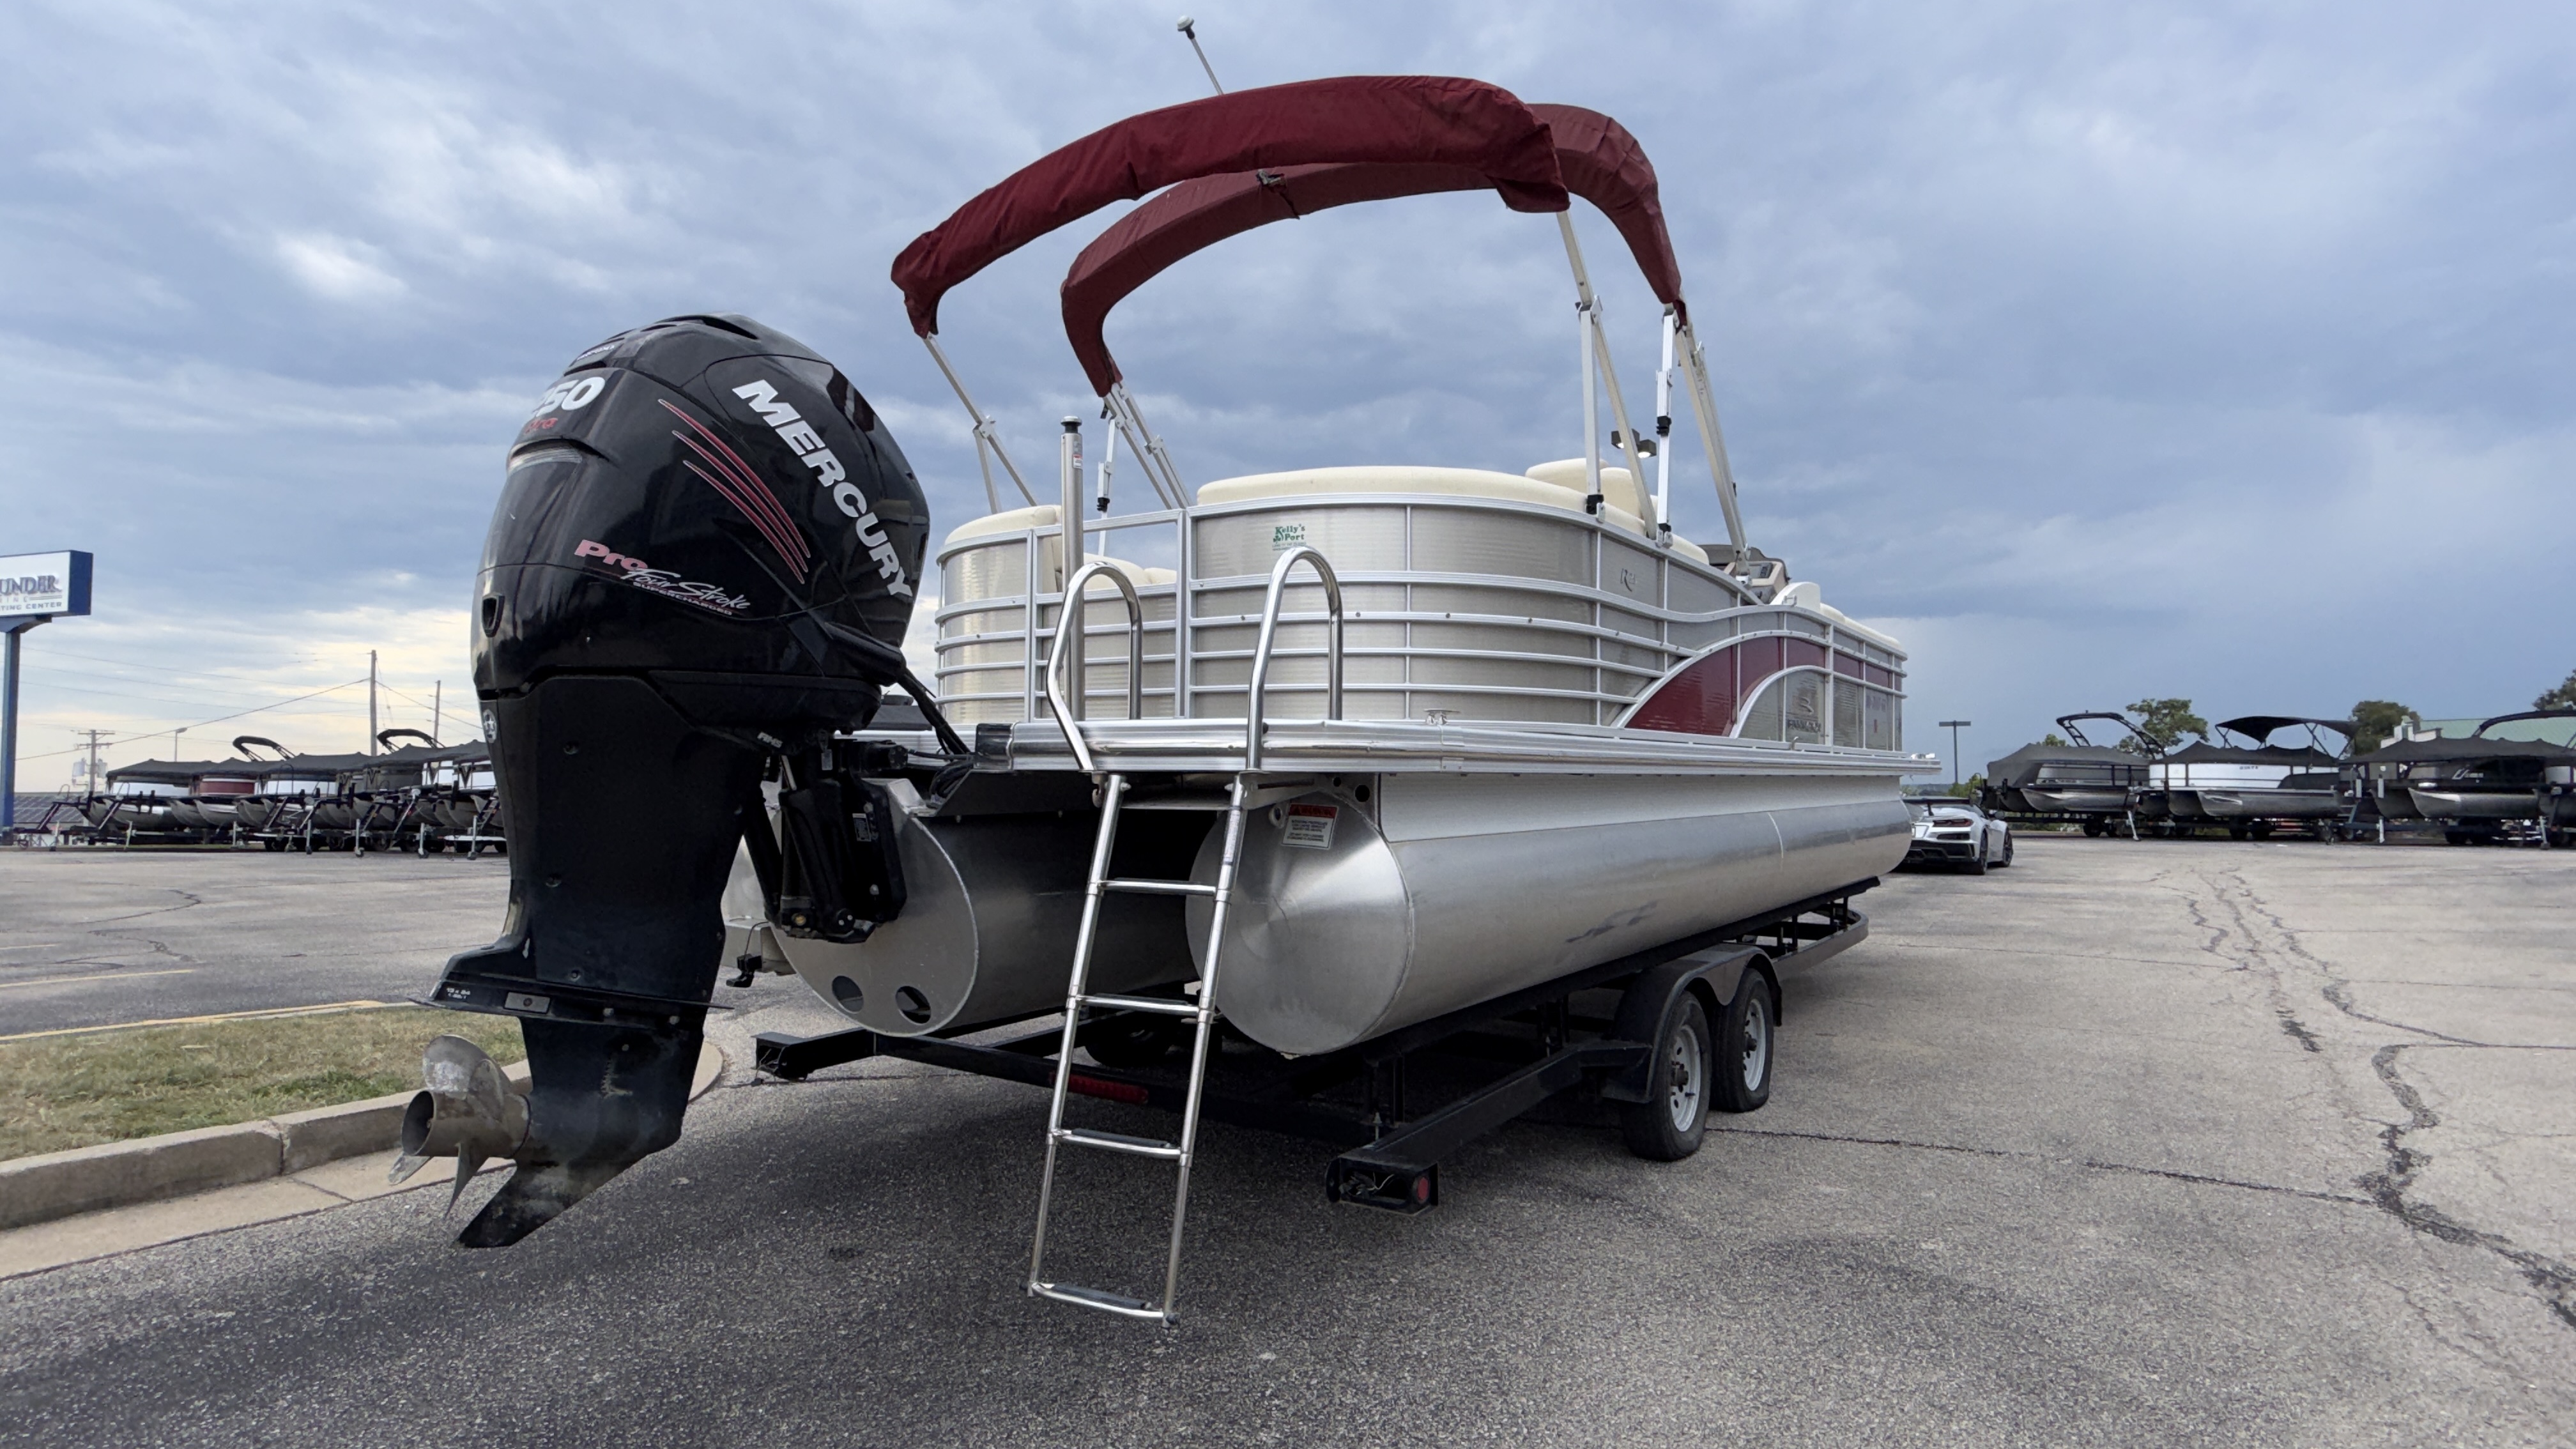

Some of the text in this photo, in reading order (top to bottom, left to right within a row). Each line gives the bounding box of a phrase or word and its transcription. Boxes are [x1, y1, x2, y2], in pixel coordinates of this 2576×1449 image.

[732, 379, 913, 597] MERCURY
[1275, 523, 1305, 535] Kelly's
[1284, 533, 1305, 541] Port
[574, 539, 648, 571] Pro
